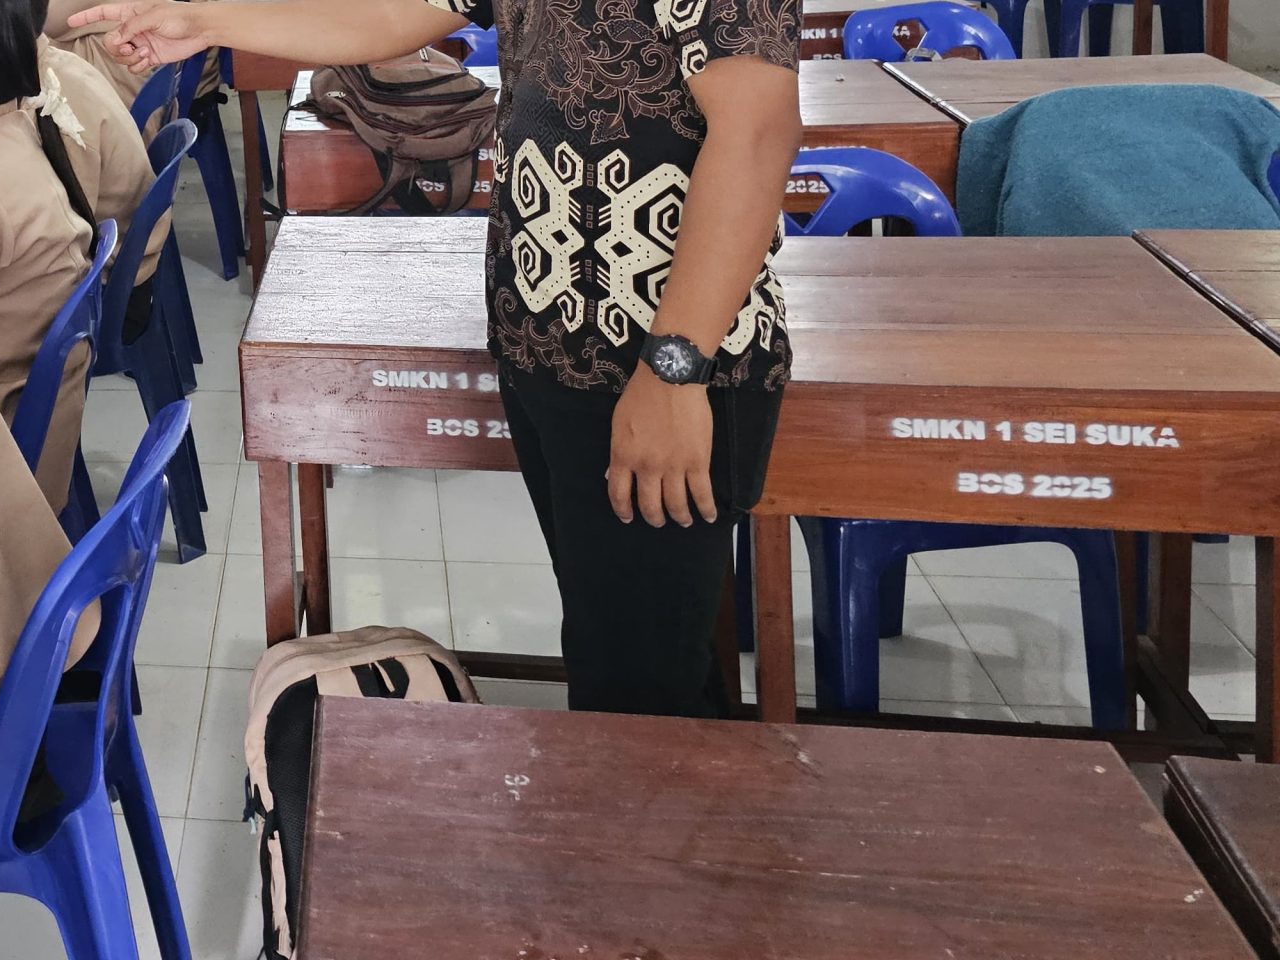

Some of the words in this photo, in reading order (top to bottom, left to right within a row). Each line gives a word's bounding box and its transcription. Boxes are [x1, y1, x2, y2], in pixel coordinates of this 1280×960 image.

[372, 369, 448, 389] SMKN
[455, 372, 468, 389] 1
[426, 418, 479, 437] BOS
[891, 417, 986, 440] SMKN
[995, 421, 1012, 441] 1
[1023, 422, 1076, 444] SEI
[1085, 423, 1180, 448] SUKA
[956, 472, 1024, 495] BOS
[1030, 474, 1113, 499] 2025
